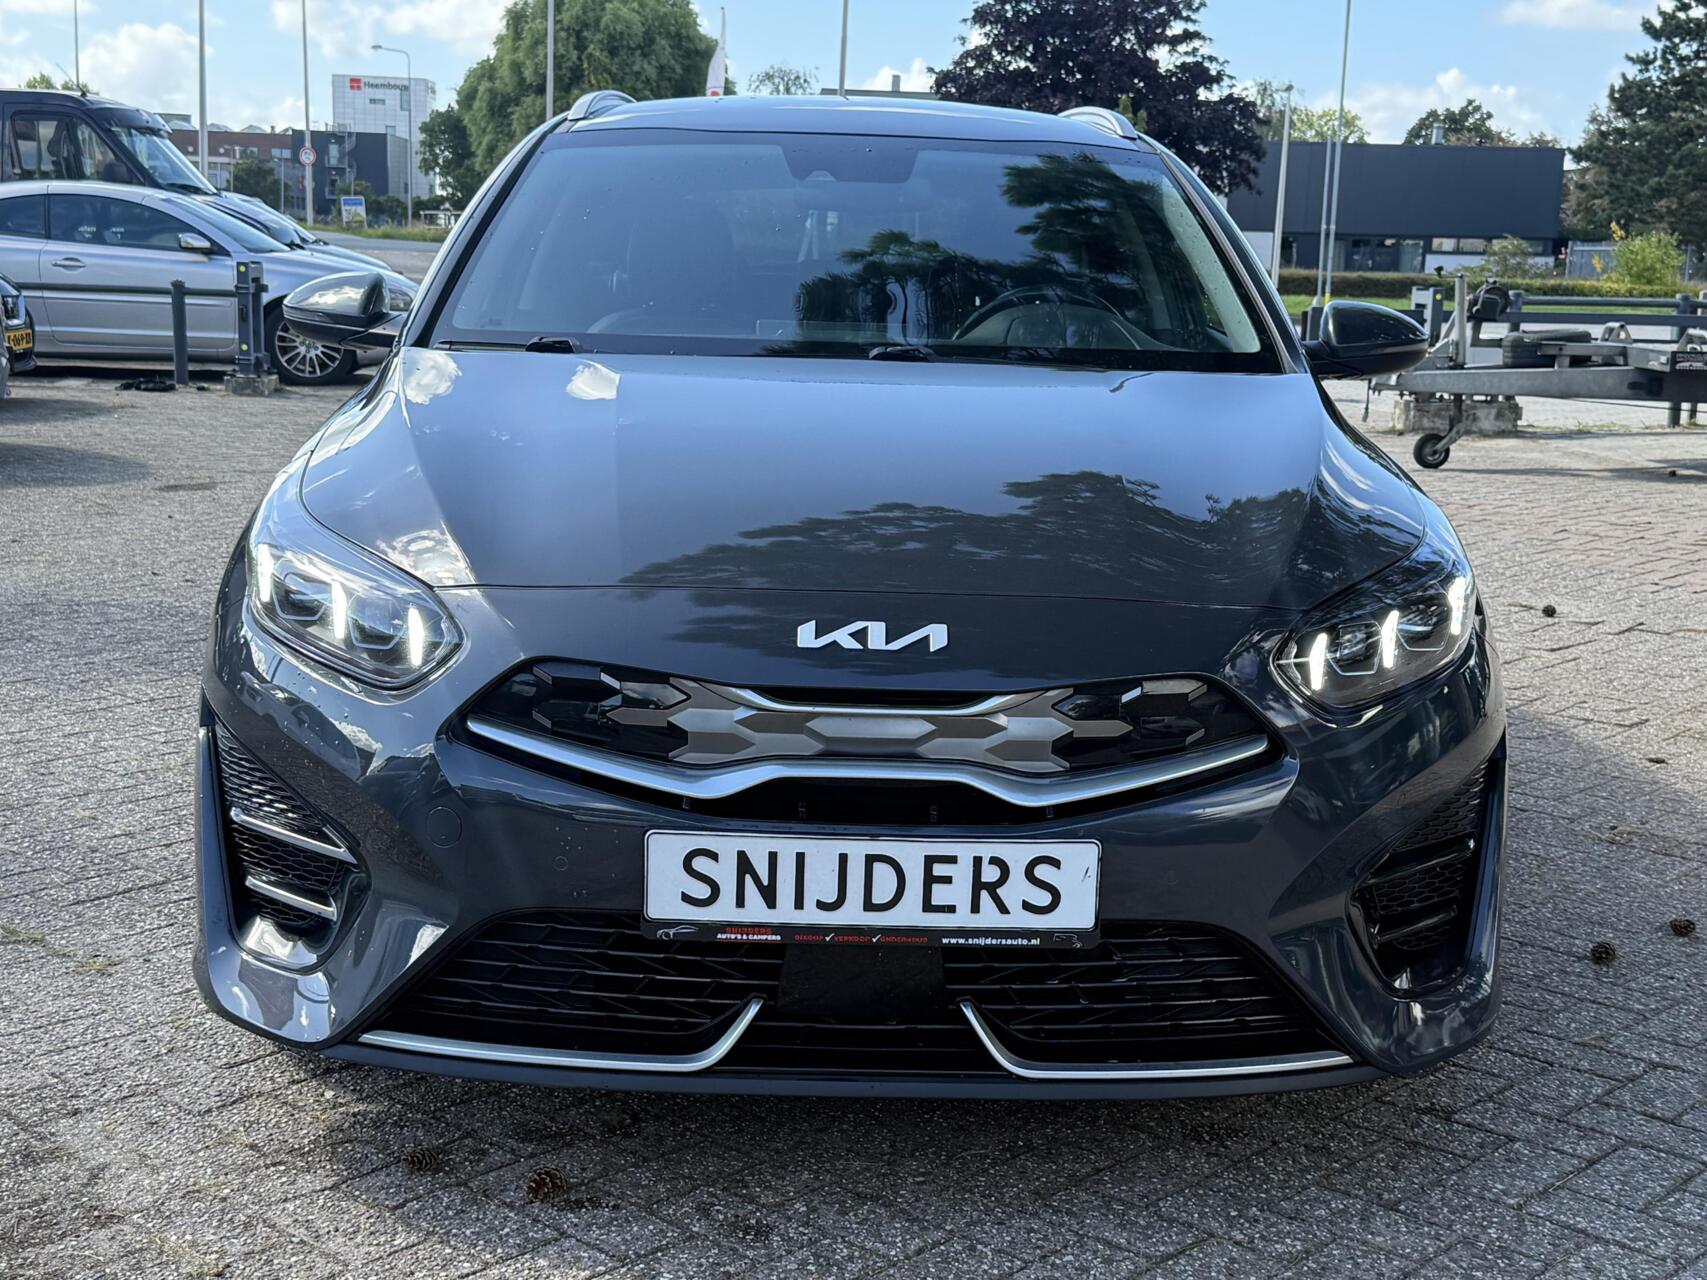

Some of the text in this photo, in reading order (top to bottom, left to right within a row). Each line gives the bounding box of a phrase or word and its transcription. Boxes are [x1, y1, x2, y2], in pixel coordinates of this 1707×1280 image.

[797, 619, 949, 653] KIA
[680, 848, 1062, 915] SNIJDERS
[941, 936, 1041, 946] www.snijdersauto.nl
